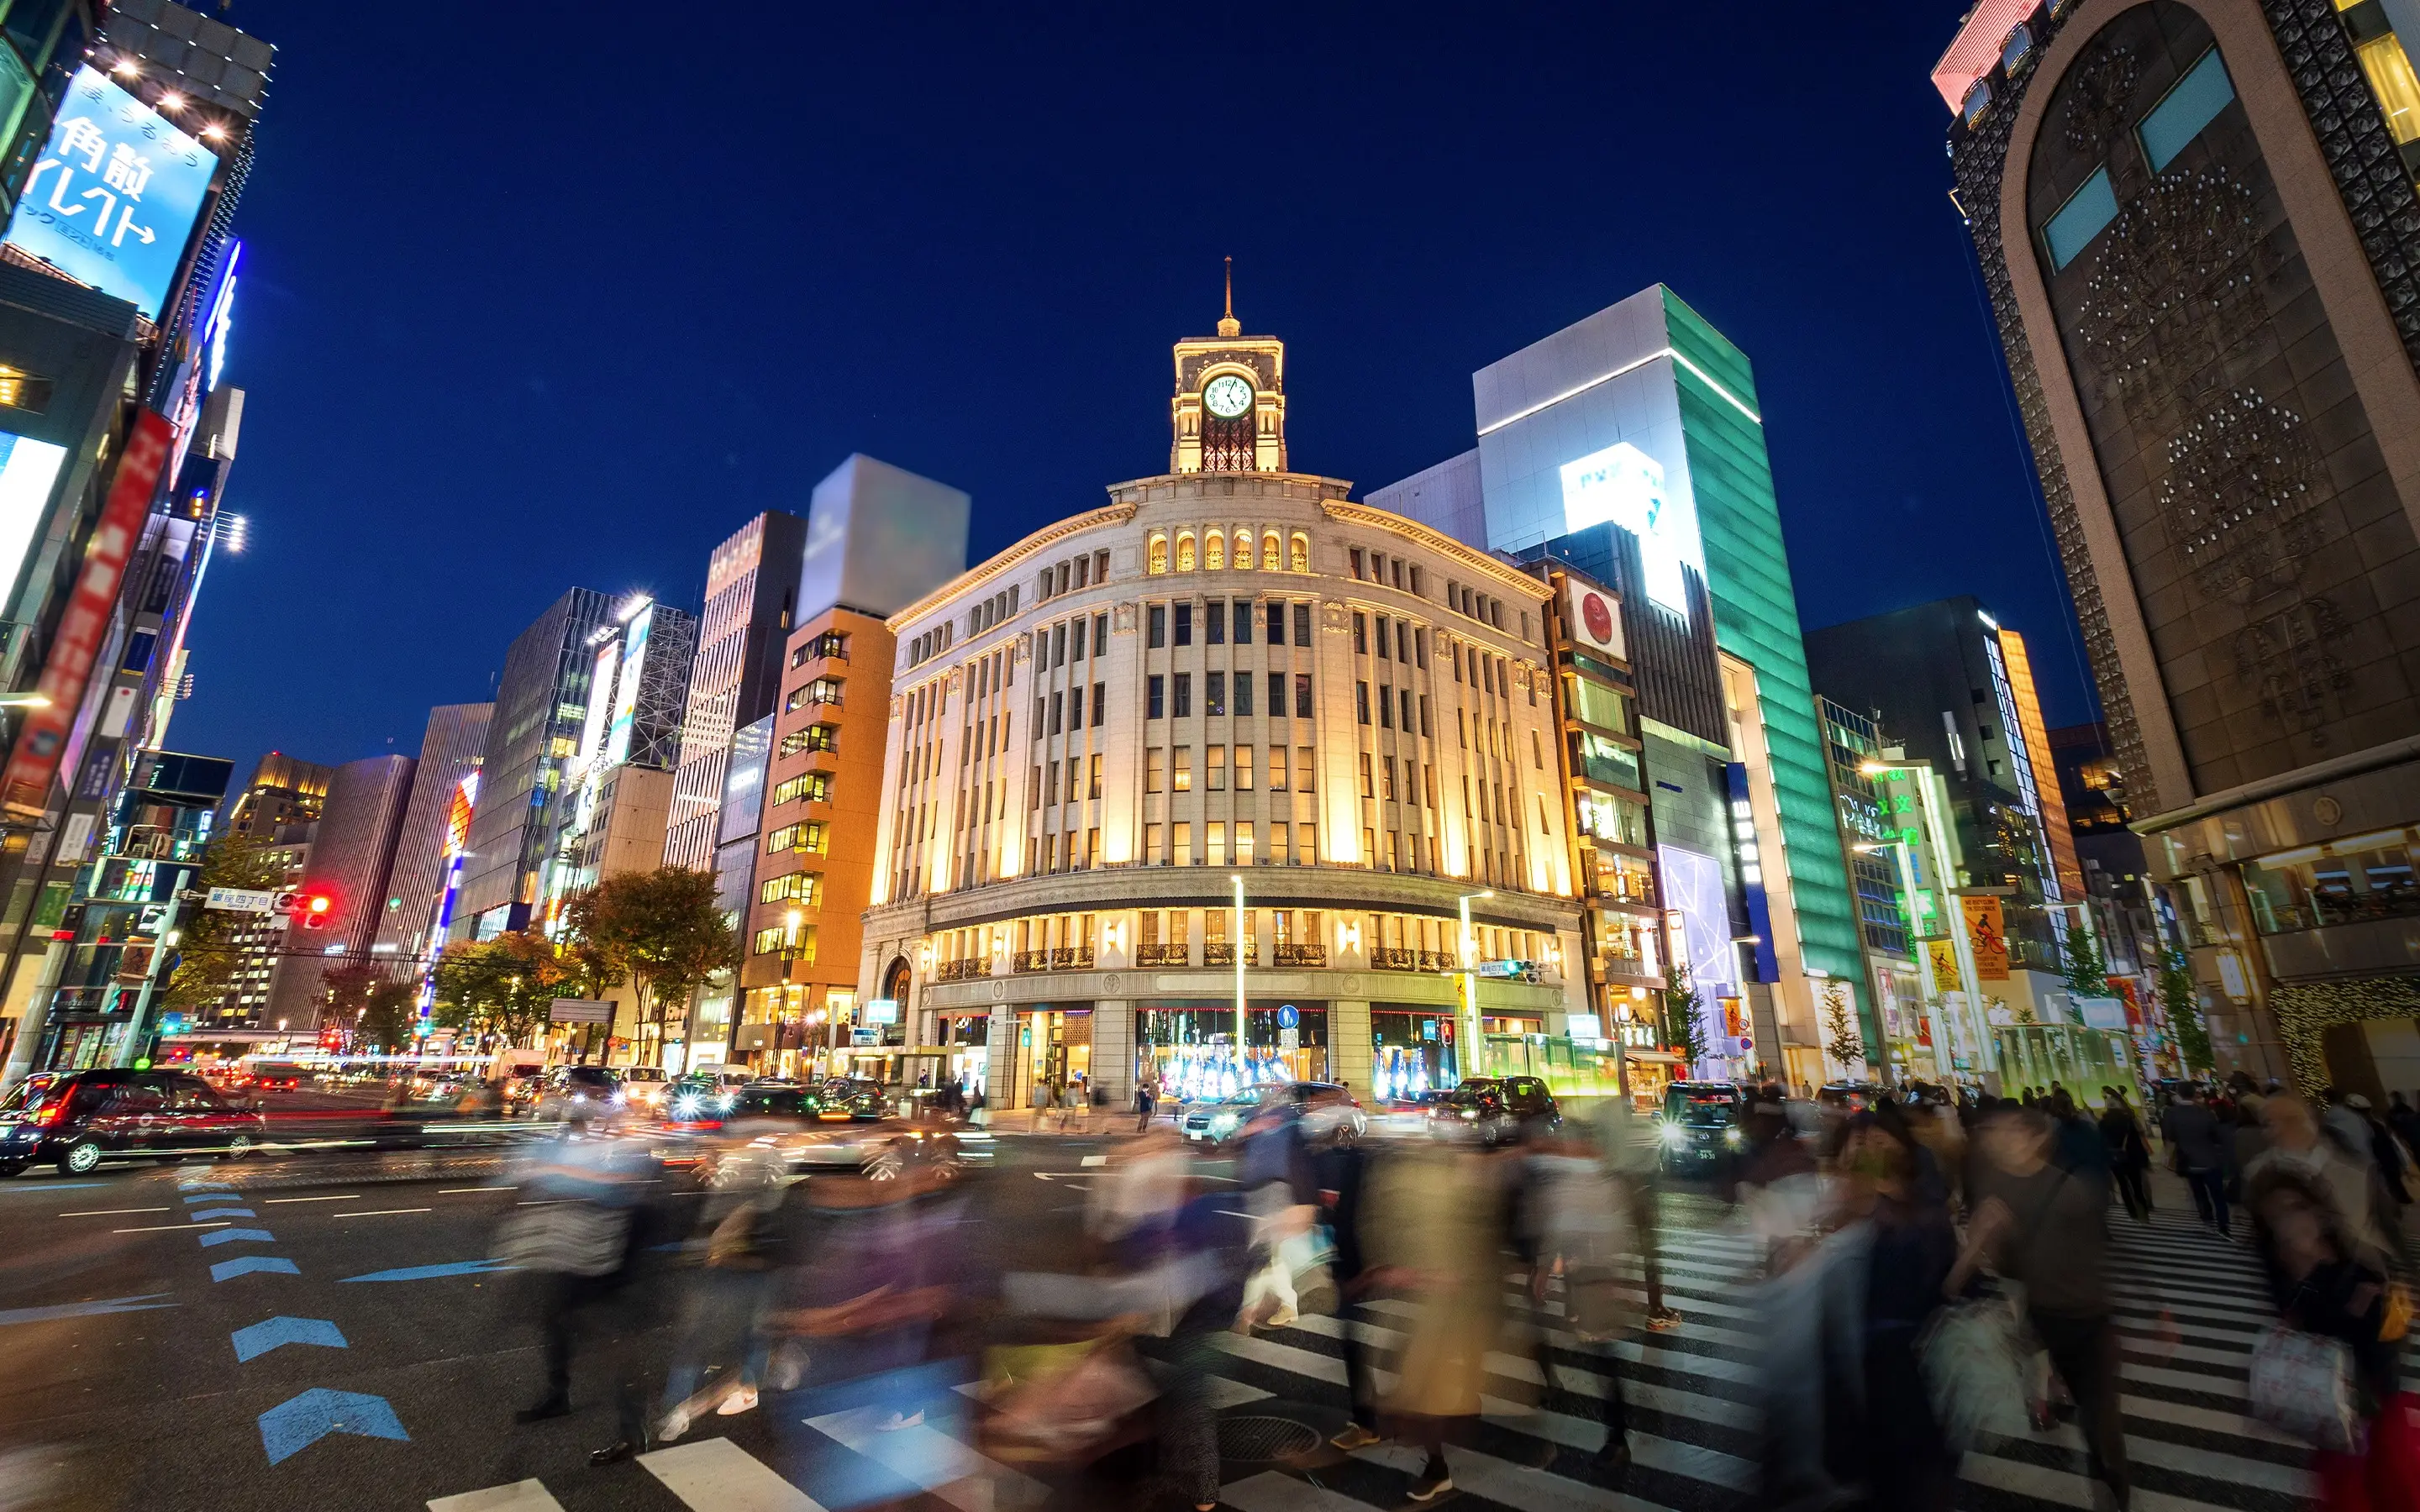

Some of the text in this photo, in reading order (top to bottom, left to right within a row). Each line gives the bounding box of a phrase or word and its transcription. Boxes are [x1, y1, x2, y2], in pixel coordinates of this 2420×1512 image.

[61, 116, 155, 202] 角散
[212, 893, 268, 906] 銀座四丁目
